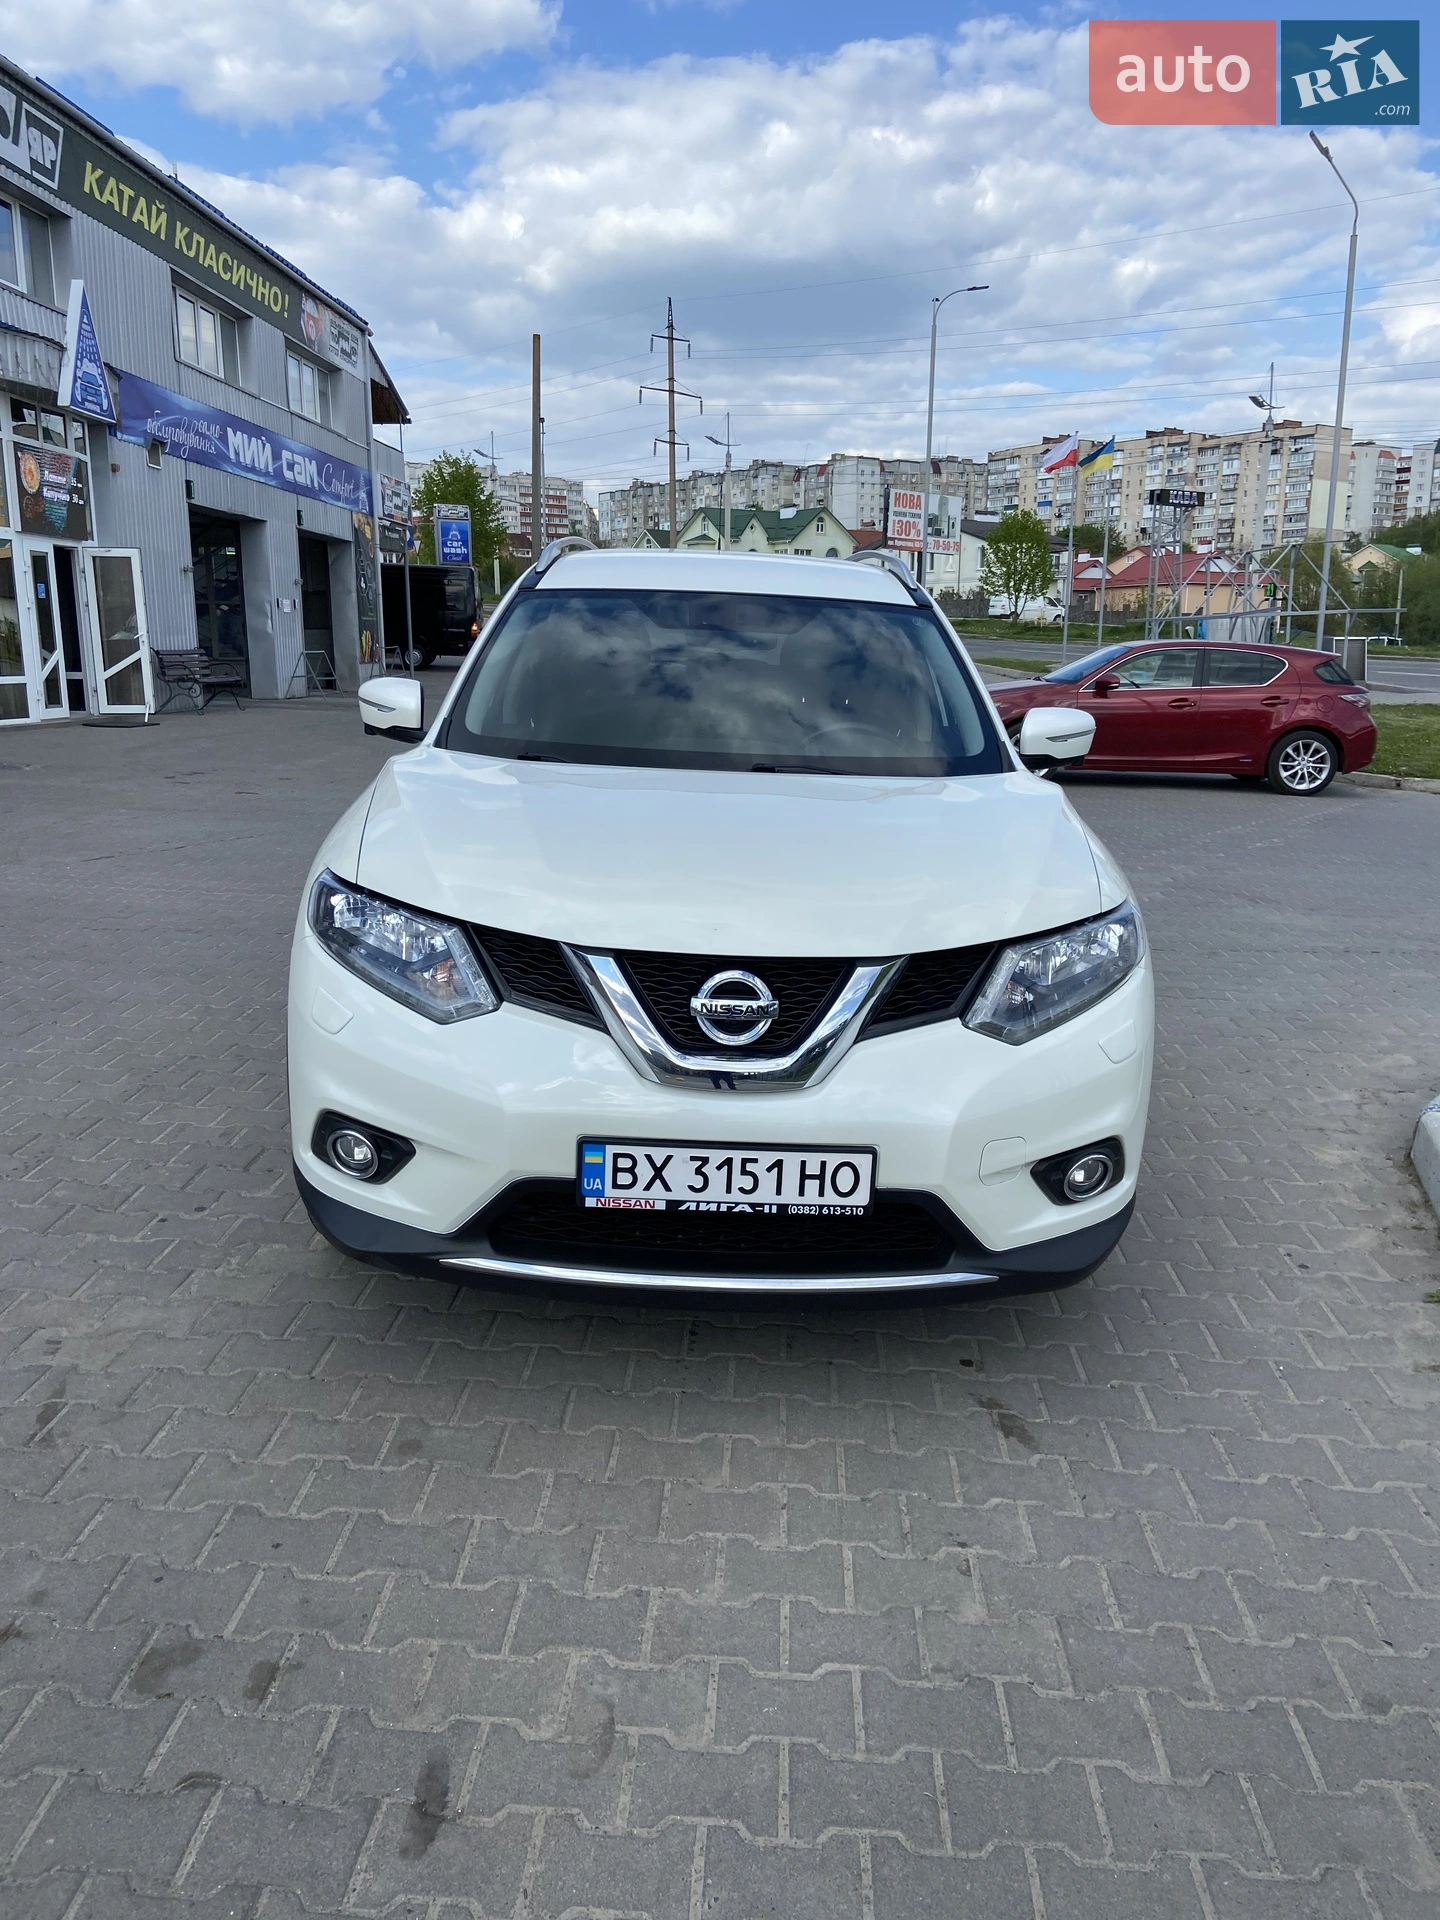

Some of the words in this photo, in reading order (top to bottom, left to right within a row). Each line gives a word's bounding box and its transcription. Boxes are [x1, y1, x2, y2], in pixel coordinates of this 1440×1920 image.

[83, 161, 168, 241] КАТАЙ
[174, 220, 289, 318] КЛАСИЧНО!
[893, 491, 922, 510] НОВА
[896, 519, 921, 538] 30%
[443, 546, 467, 554] wash
[932, 539, 960, 552] 70-50-75
[700, 1002, 769, 1016] NISSAN
[611, 1152, 674, 1193] BX
[686, 1154, 784, 1197] 3151
[798, 1159, 860, 1199] HO
[583, 1178, 603, 1191] UA
[595, 1198, 656, 1209] NISSAN
[788, 1204, 820, 1215] (0382)
[822, 1206, 864, 1216] 613-510
